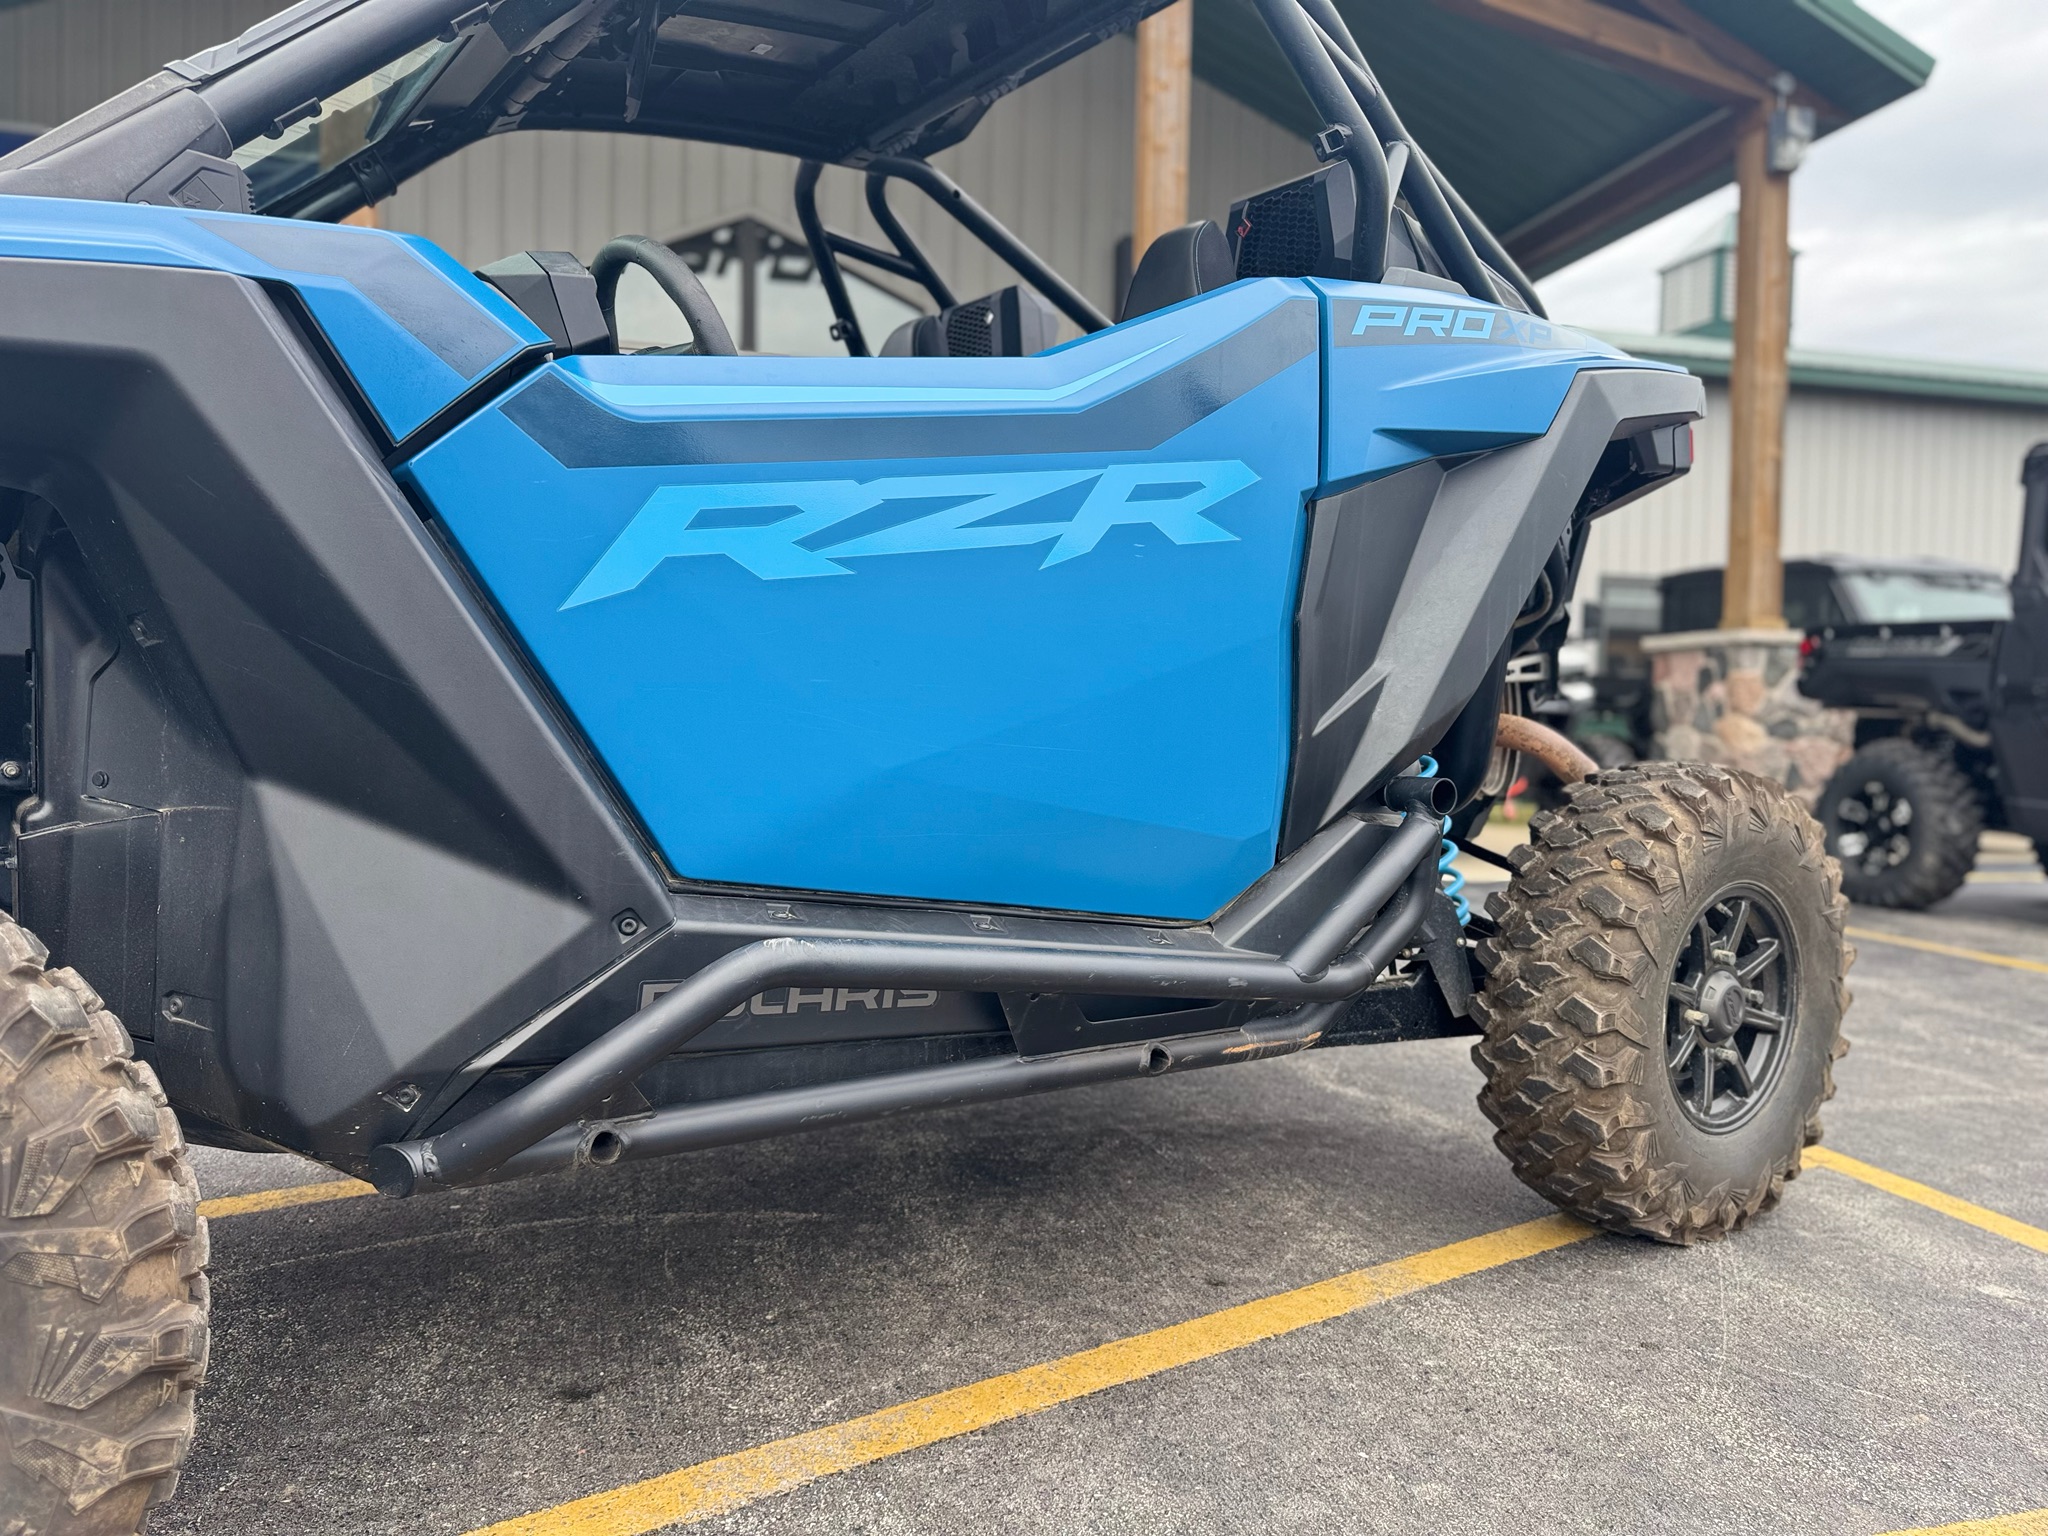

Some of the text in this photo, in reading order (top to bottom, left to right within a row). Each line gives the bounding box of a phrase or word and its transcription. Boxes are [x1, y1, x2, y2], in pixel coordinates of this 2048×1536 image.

[1351, 305, 1552, 345] PRO XP
[557, 460, 1261, 611] RZR
[640, 983, 938, 1017] LARIS
